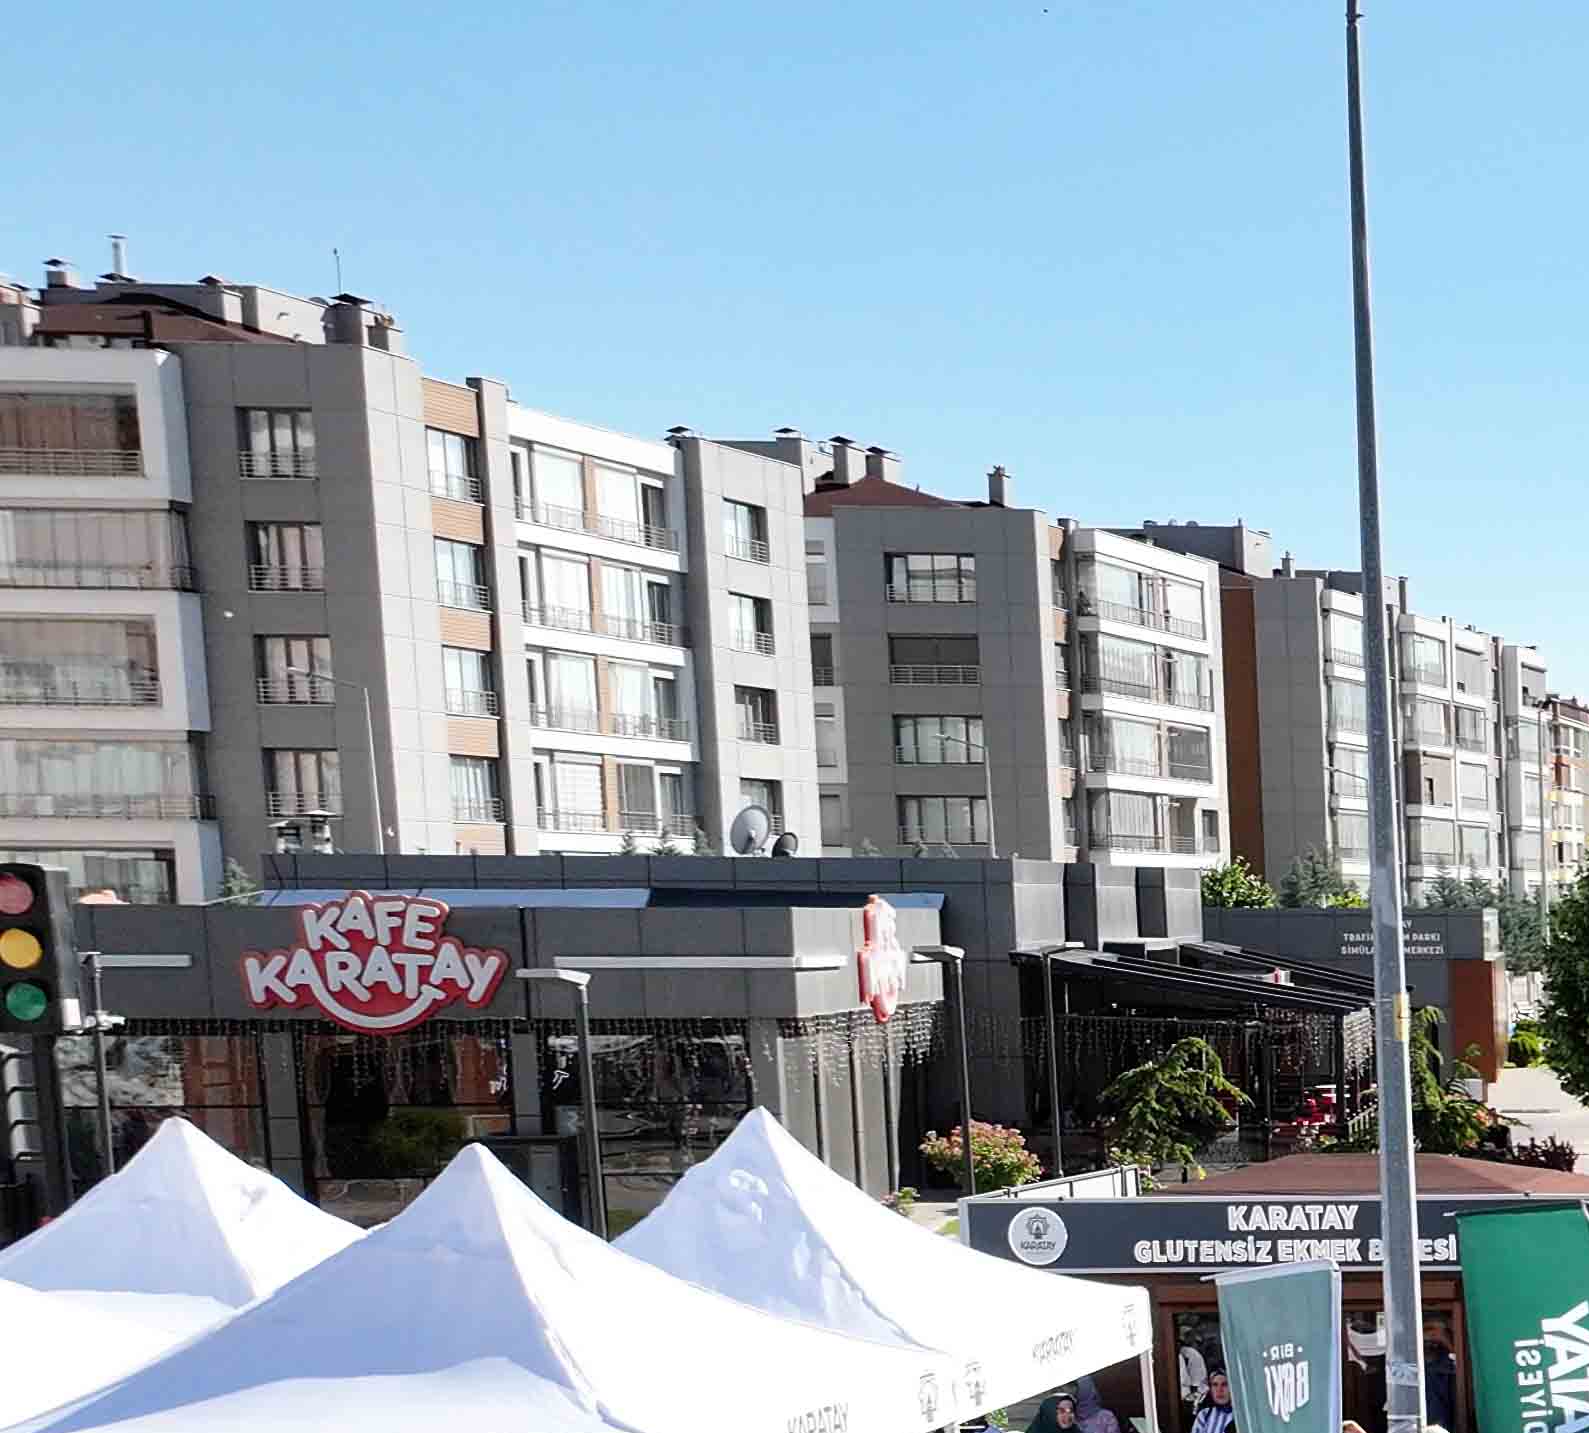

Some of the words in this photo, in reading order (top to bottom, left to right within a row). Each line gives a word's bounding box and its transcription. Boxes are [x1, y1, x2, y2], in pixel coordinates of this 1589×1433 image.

[303, 897, 441, 950] KAFE
[1341, 945, 1376, 955] SİMÜLA
[245, 942, 502, 1004] KARATAY
[1227, 1205, 1359, 1232] KARATAY
[1134, 1235, 1273, 1264] GLUTENSİZ
[1278, 1238, 1362, 1263] EKMEK
[1368, 1234, 1458, 1262] BESİ
